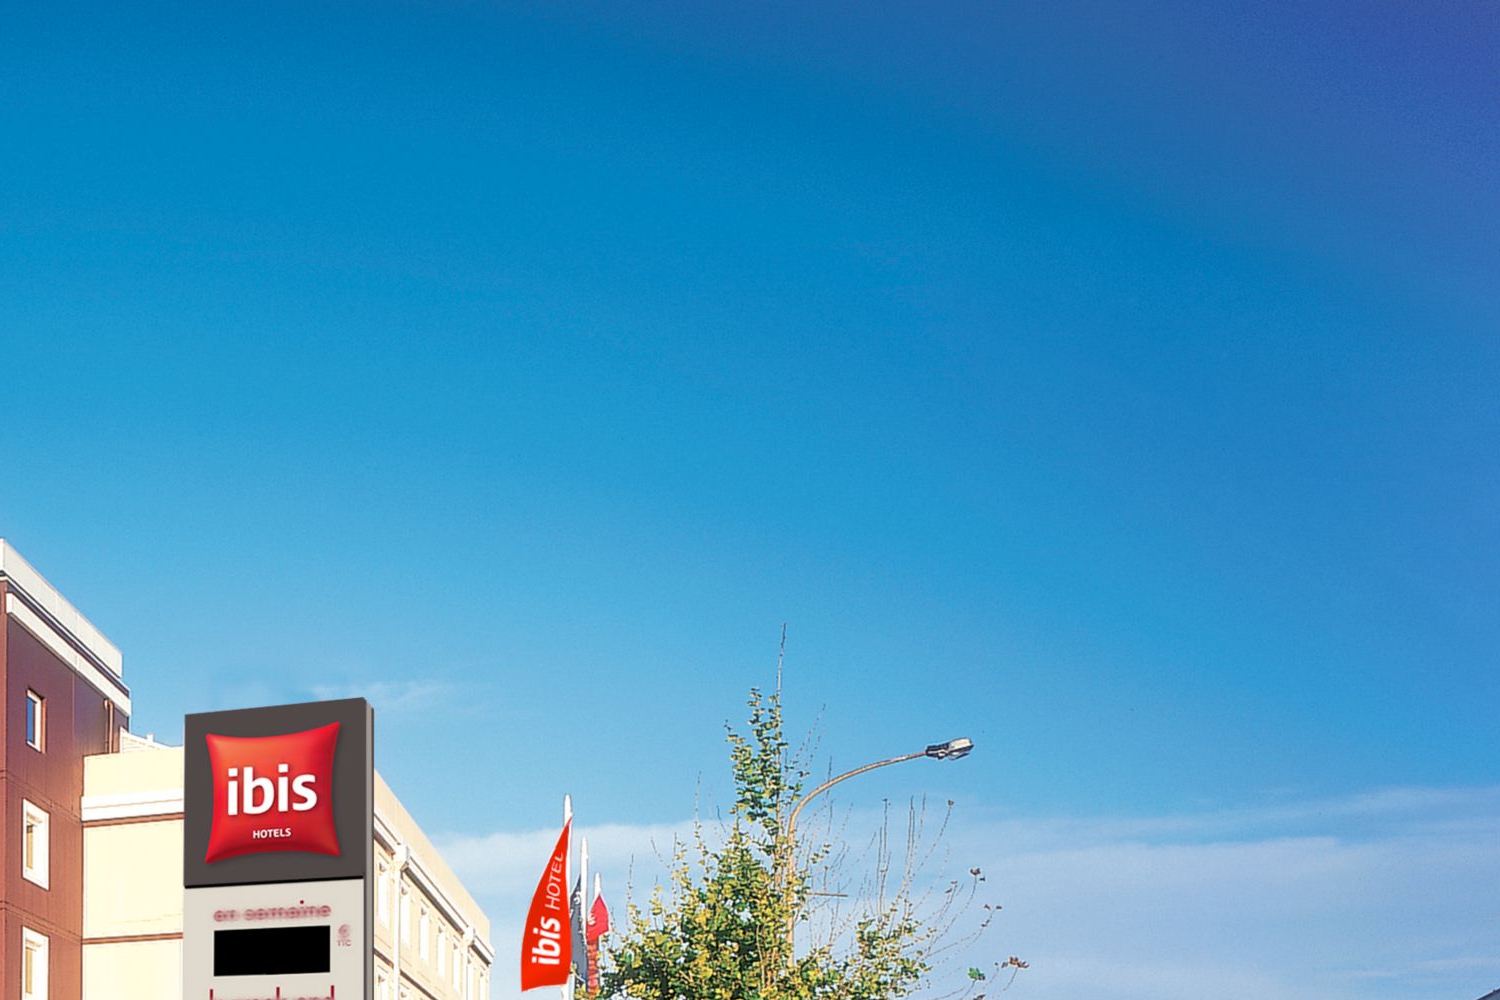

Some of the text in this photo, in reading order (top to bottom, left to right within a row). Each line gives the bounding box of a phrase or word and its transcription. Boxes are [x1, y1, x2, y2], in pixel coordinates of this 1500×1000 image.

[227, 763, 318, 816] ibis
[252, 827, 292, 839] HOTELS
[532, 851, 564, 965] ibis HOTEL
